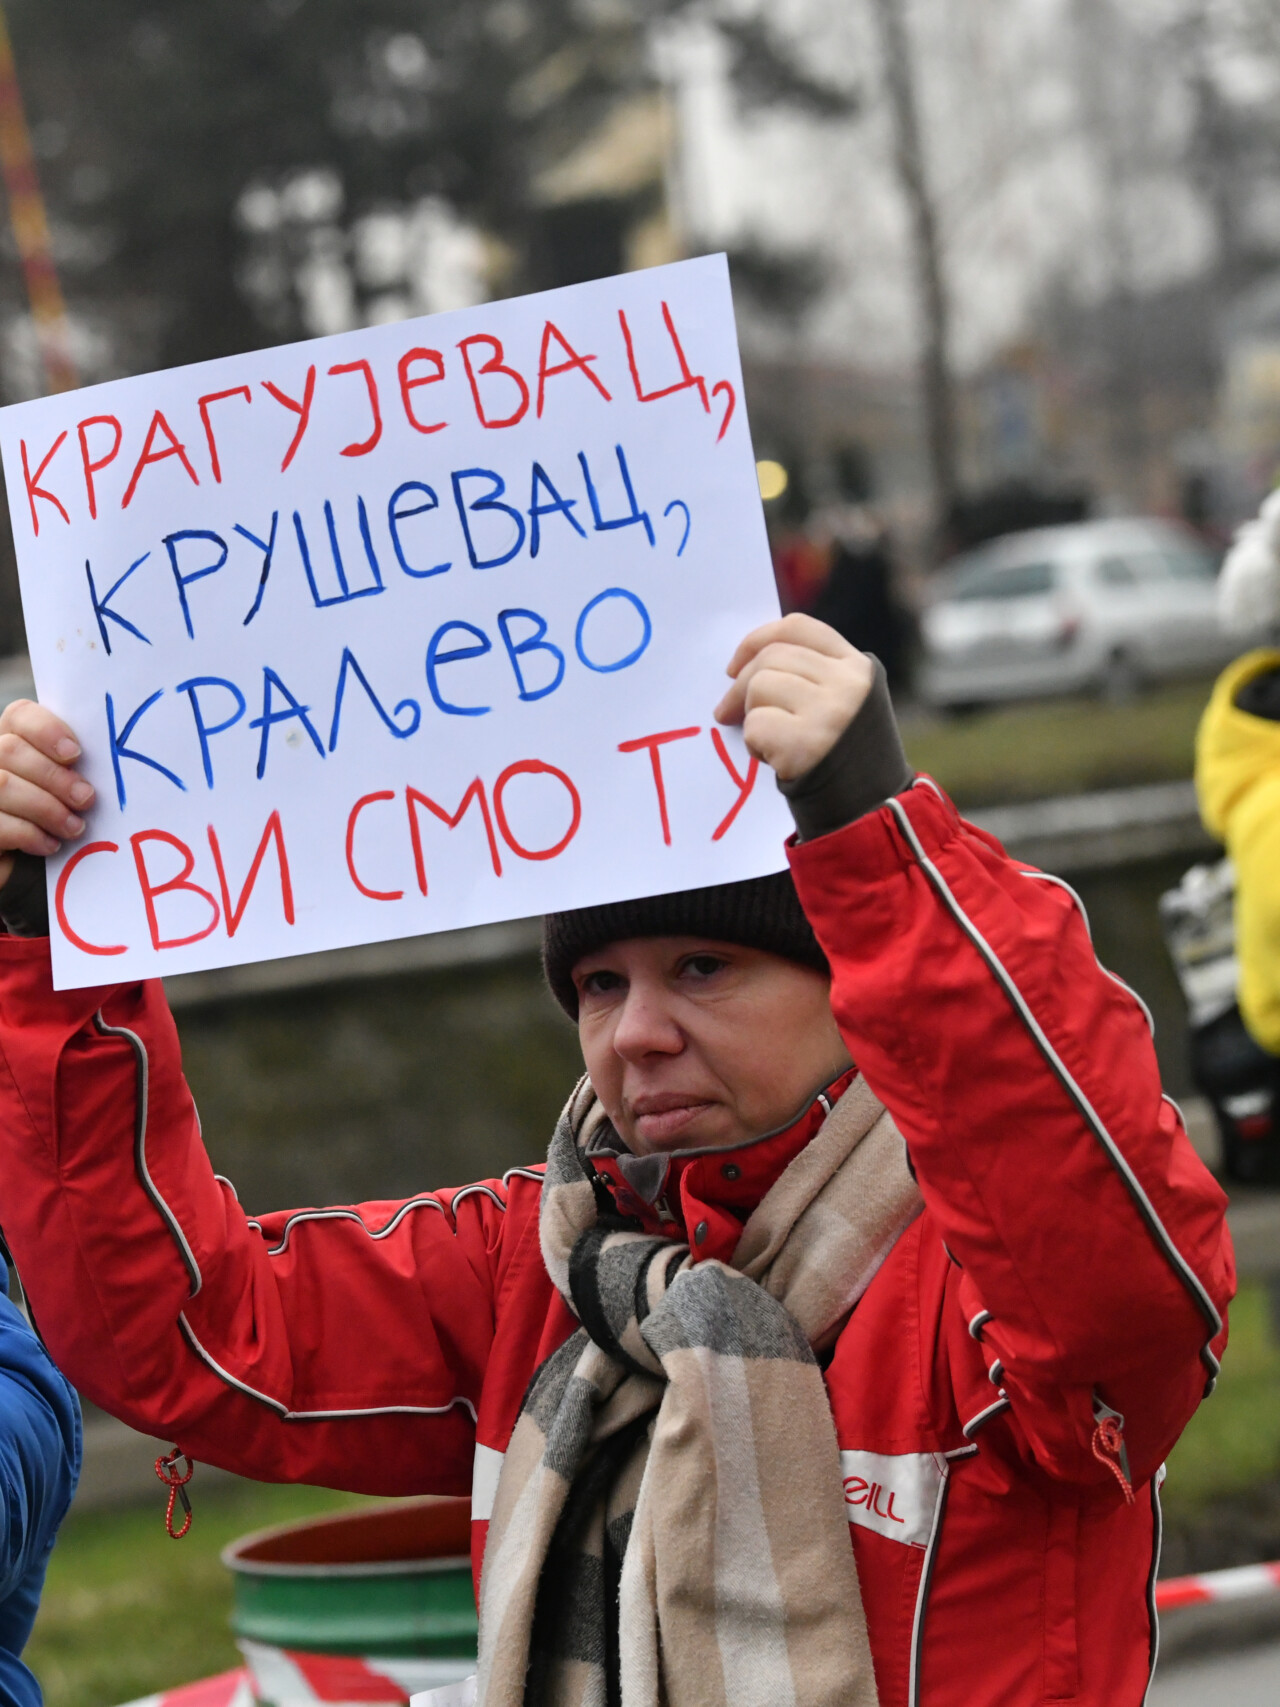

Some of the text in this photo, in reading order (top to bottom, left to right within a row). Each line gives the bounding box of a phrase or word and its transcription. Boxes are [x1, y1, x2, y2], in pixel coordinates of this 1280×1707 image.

[54, 726, 761, 957] СВИ СМО ТУ
